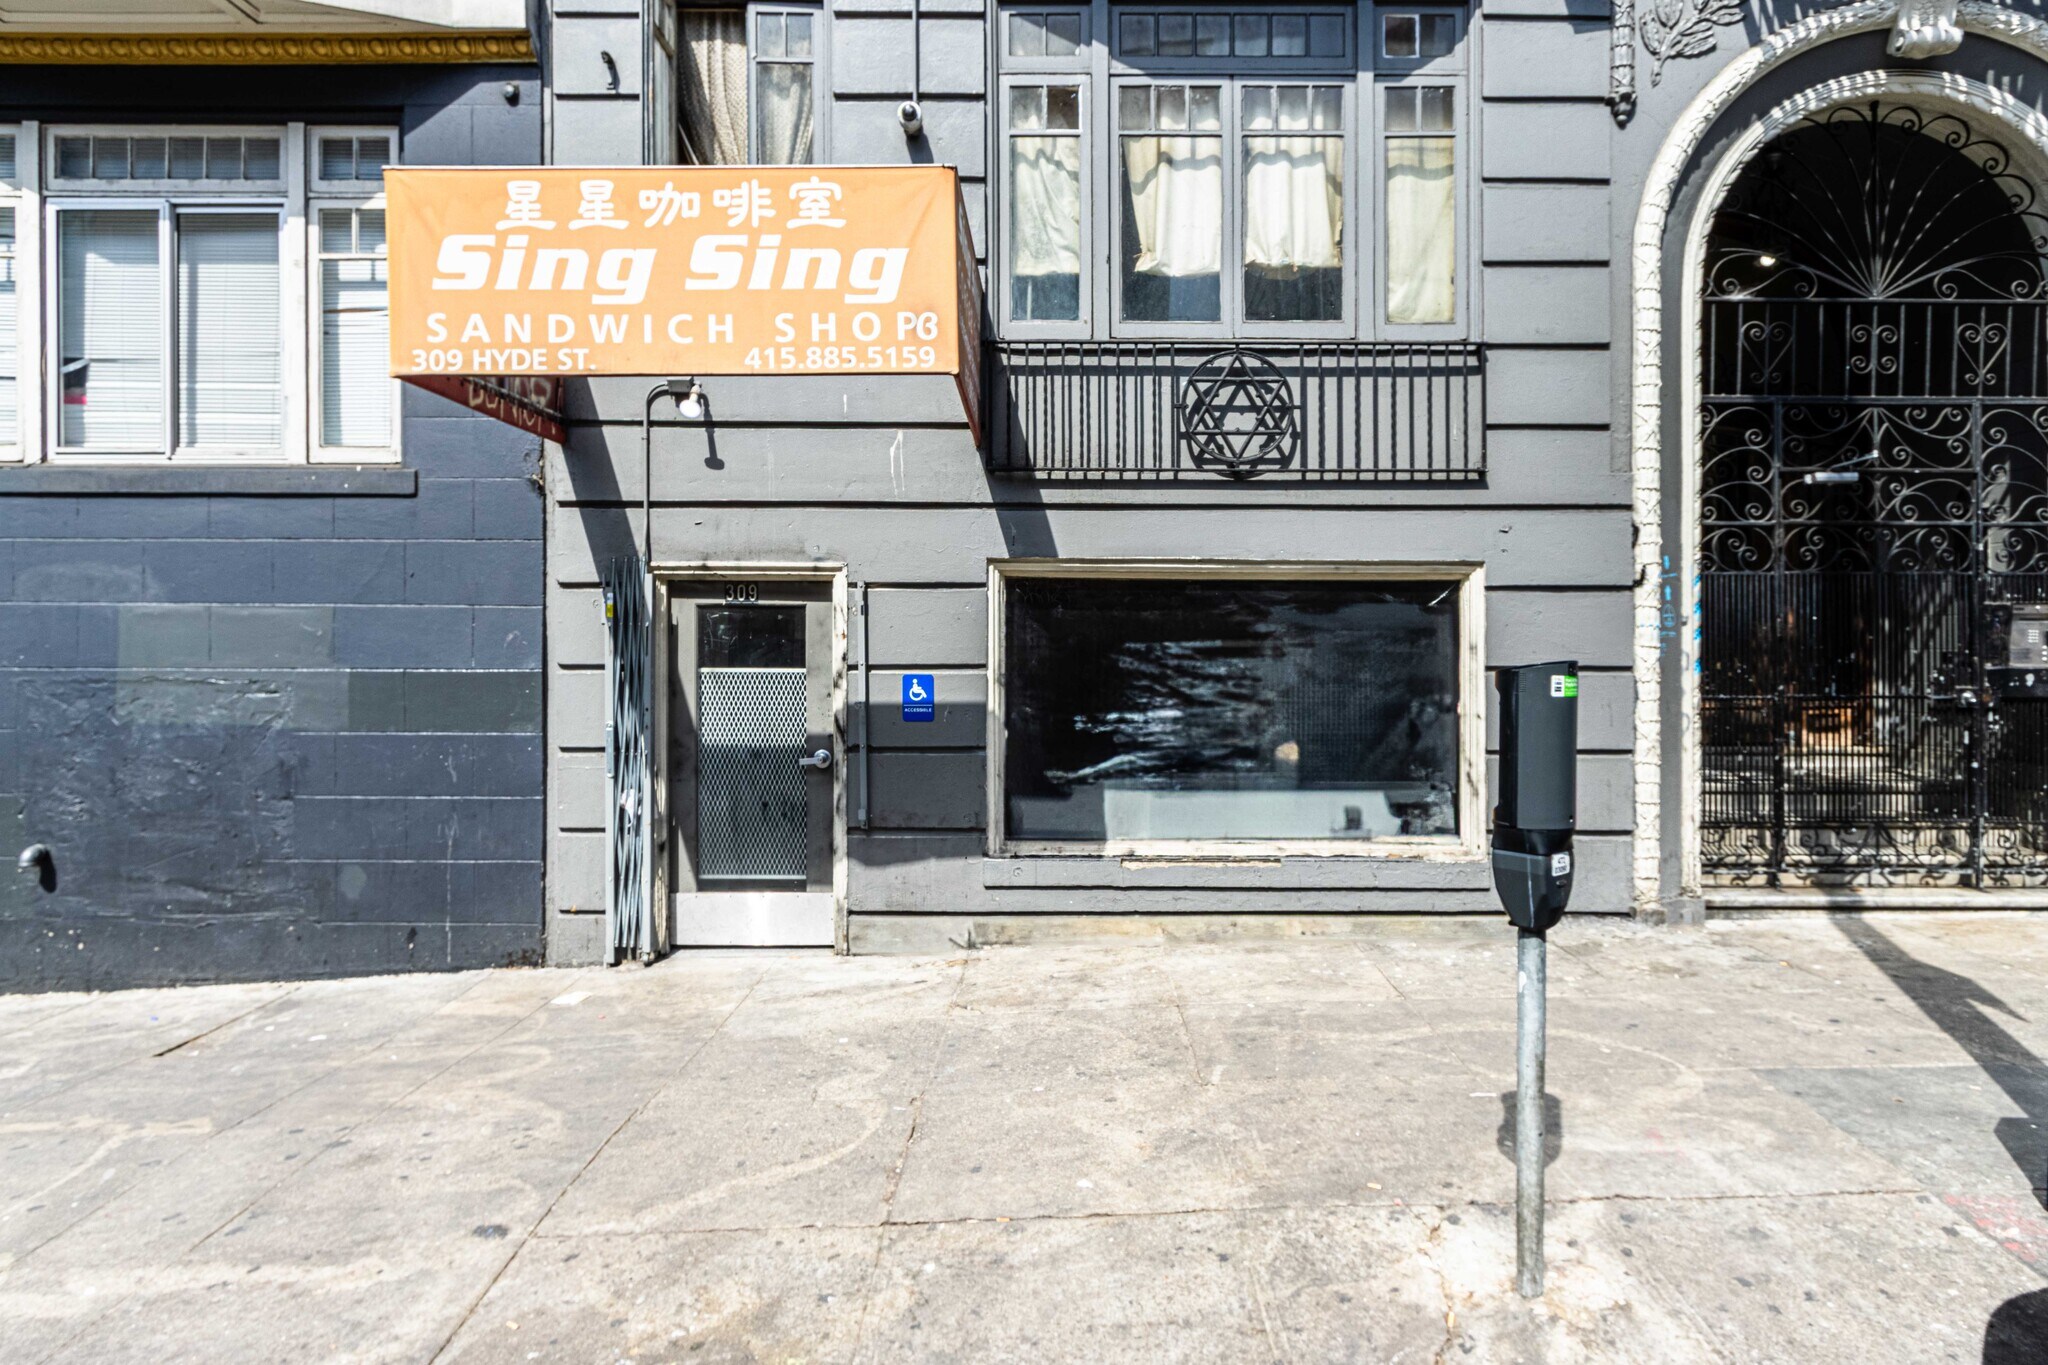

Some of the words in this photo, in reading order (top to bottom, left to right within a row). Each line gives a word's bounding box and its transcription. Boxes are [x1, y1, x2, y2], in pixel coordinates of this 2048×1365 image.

[496, 176, 846, 230] 星星咖啡室
[432, 234, 657, 305] Sing
[685, 234, 909, 304] Sing
[427, 312, 734, 344] SANDWICH
[411, 349, 463, 372] 309
[473, 349, 547, 371] HYDE
[558, 348, 597, 371] ST.
[744, 346, 936, 370] 415.885.5159
[726, 584, 757, 601] 309
